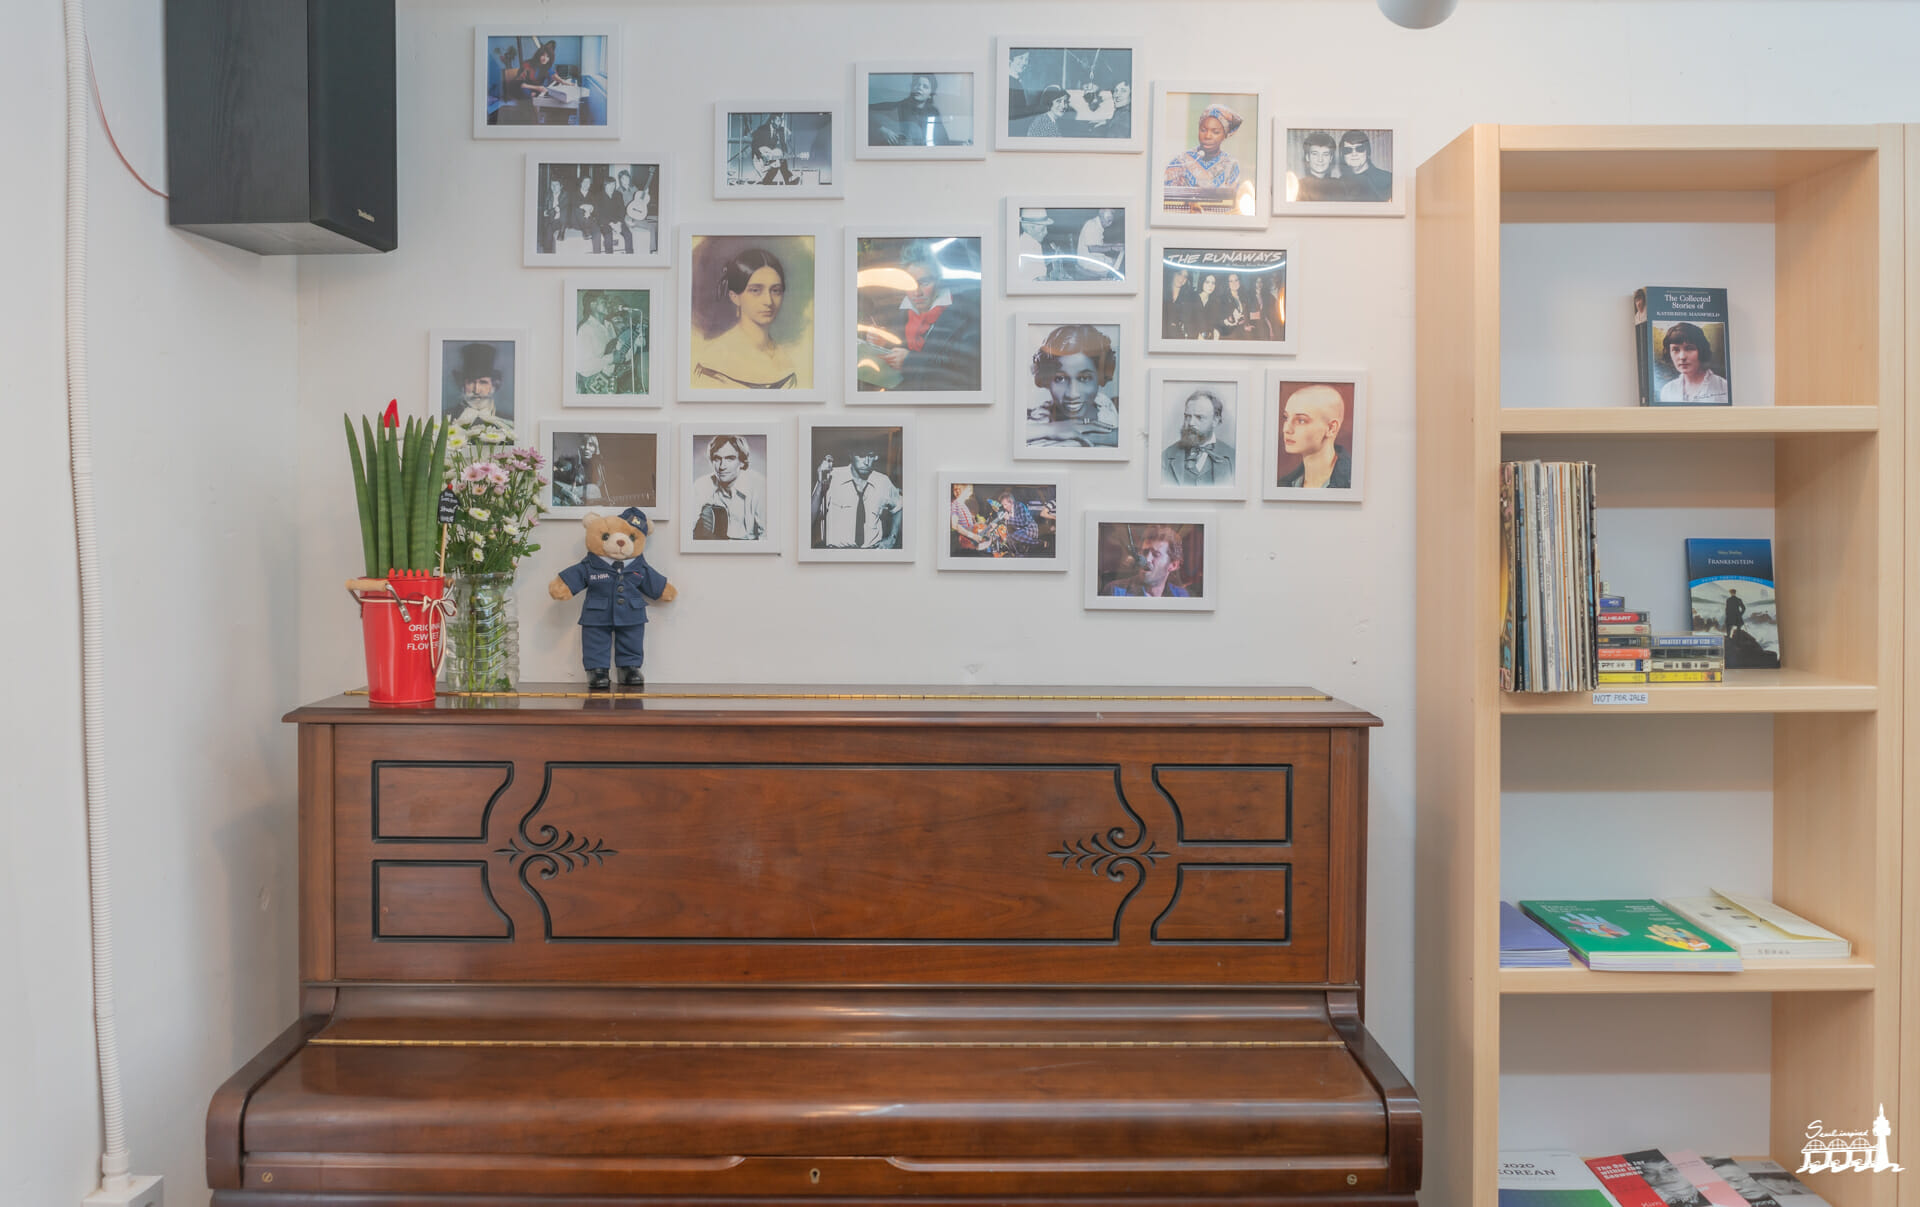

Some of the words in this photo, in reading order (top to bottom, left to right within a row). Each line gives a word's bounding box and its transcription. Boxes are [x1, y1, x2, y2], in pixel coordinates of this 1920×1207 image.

[1167, 254, 1200, 264] THE
[1202, 252, 1283, 263] RUNAWAYS
[1664, 294, 1678, 302] The
[1679, 294, 1711, 303] Collected
[1697, 302, 1705, 310] of
[408, 622, 441, 632] ORIGNA
[413, 632, 439, 641] SWET
[1594, 694, 1611, 703] NOT
[1614, 694, 1628, 702] FOR
